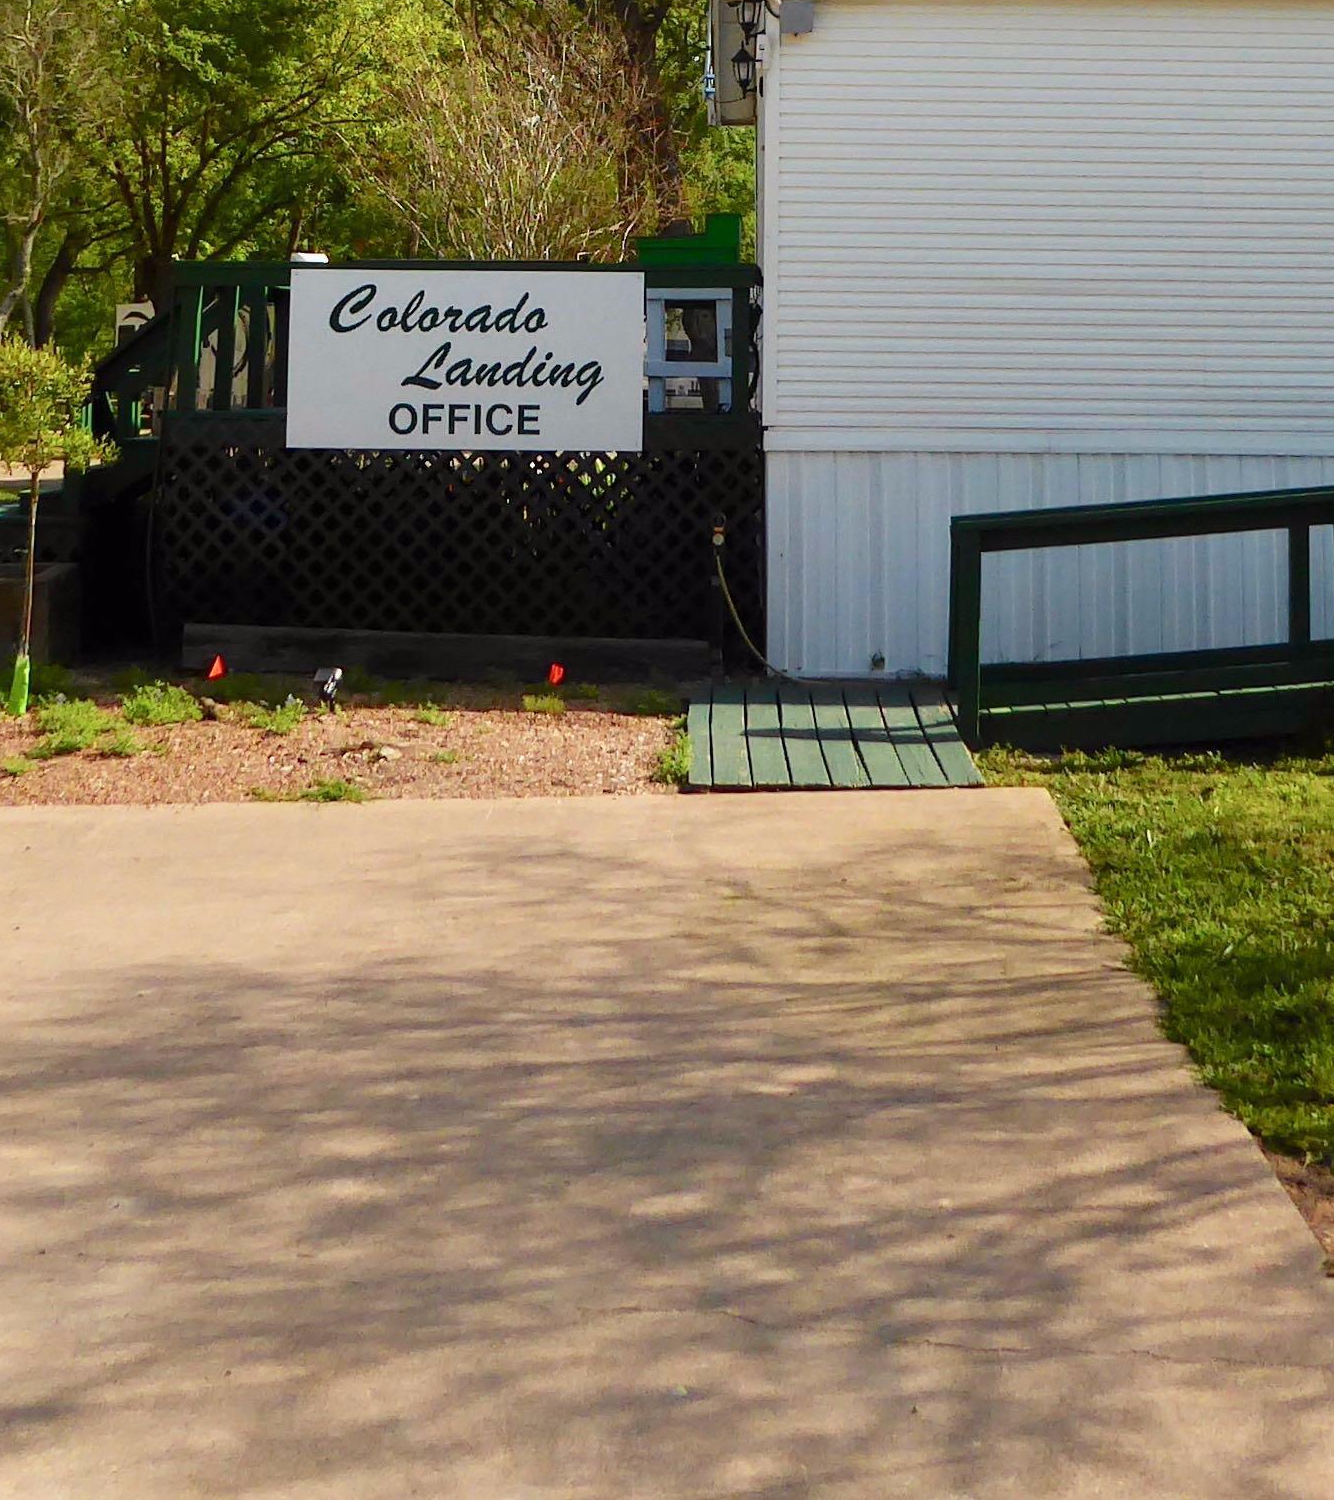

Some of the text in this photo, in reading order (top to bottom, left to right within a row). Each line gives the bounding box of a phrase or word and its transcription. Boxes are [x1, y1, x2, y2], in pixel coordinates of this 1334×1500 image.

[328, 283, 549, 334] Colorado
[400, 341, 604, 406] Landing
[388, 403, 541, 435] OFFICE
